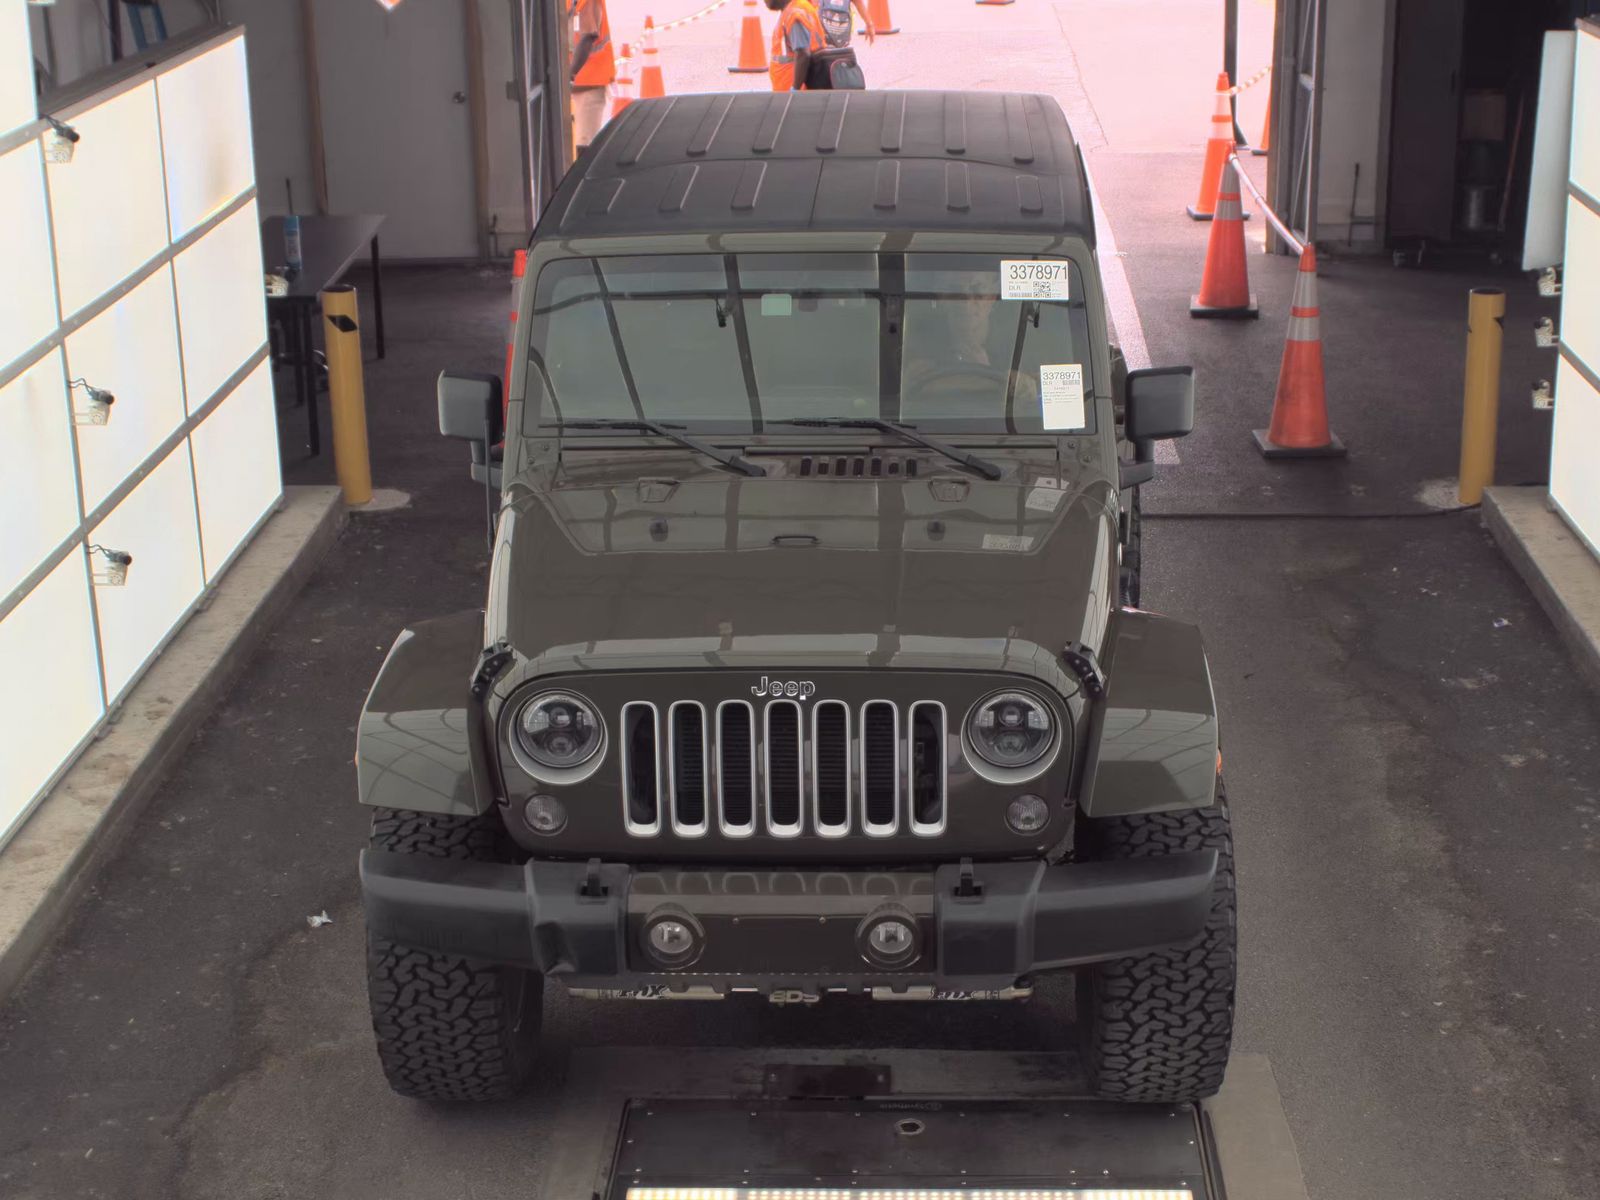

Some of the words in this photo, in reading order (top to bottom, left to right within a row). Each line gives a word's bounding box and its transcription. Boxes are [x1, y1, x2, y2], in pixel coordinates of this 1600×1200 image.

[1010, 264, 1067, 280] 3378971
[1042, 371, 1081, 380] 3378971
[751, 676, 816, 701] Jeep
